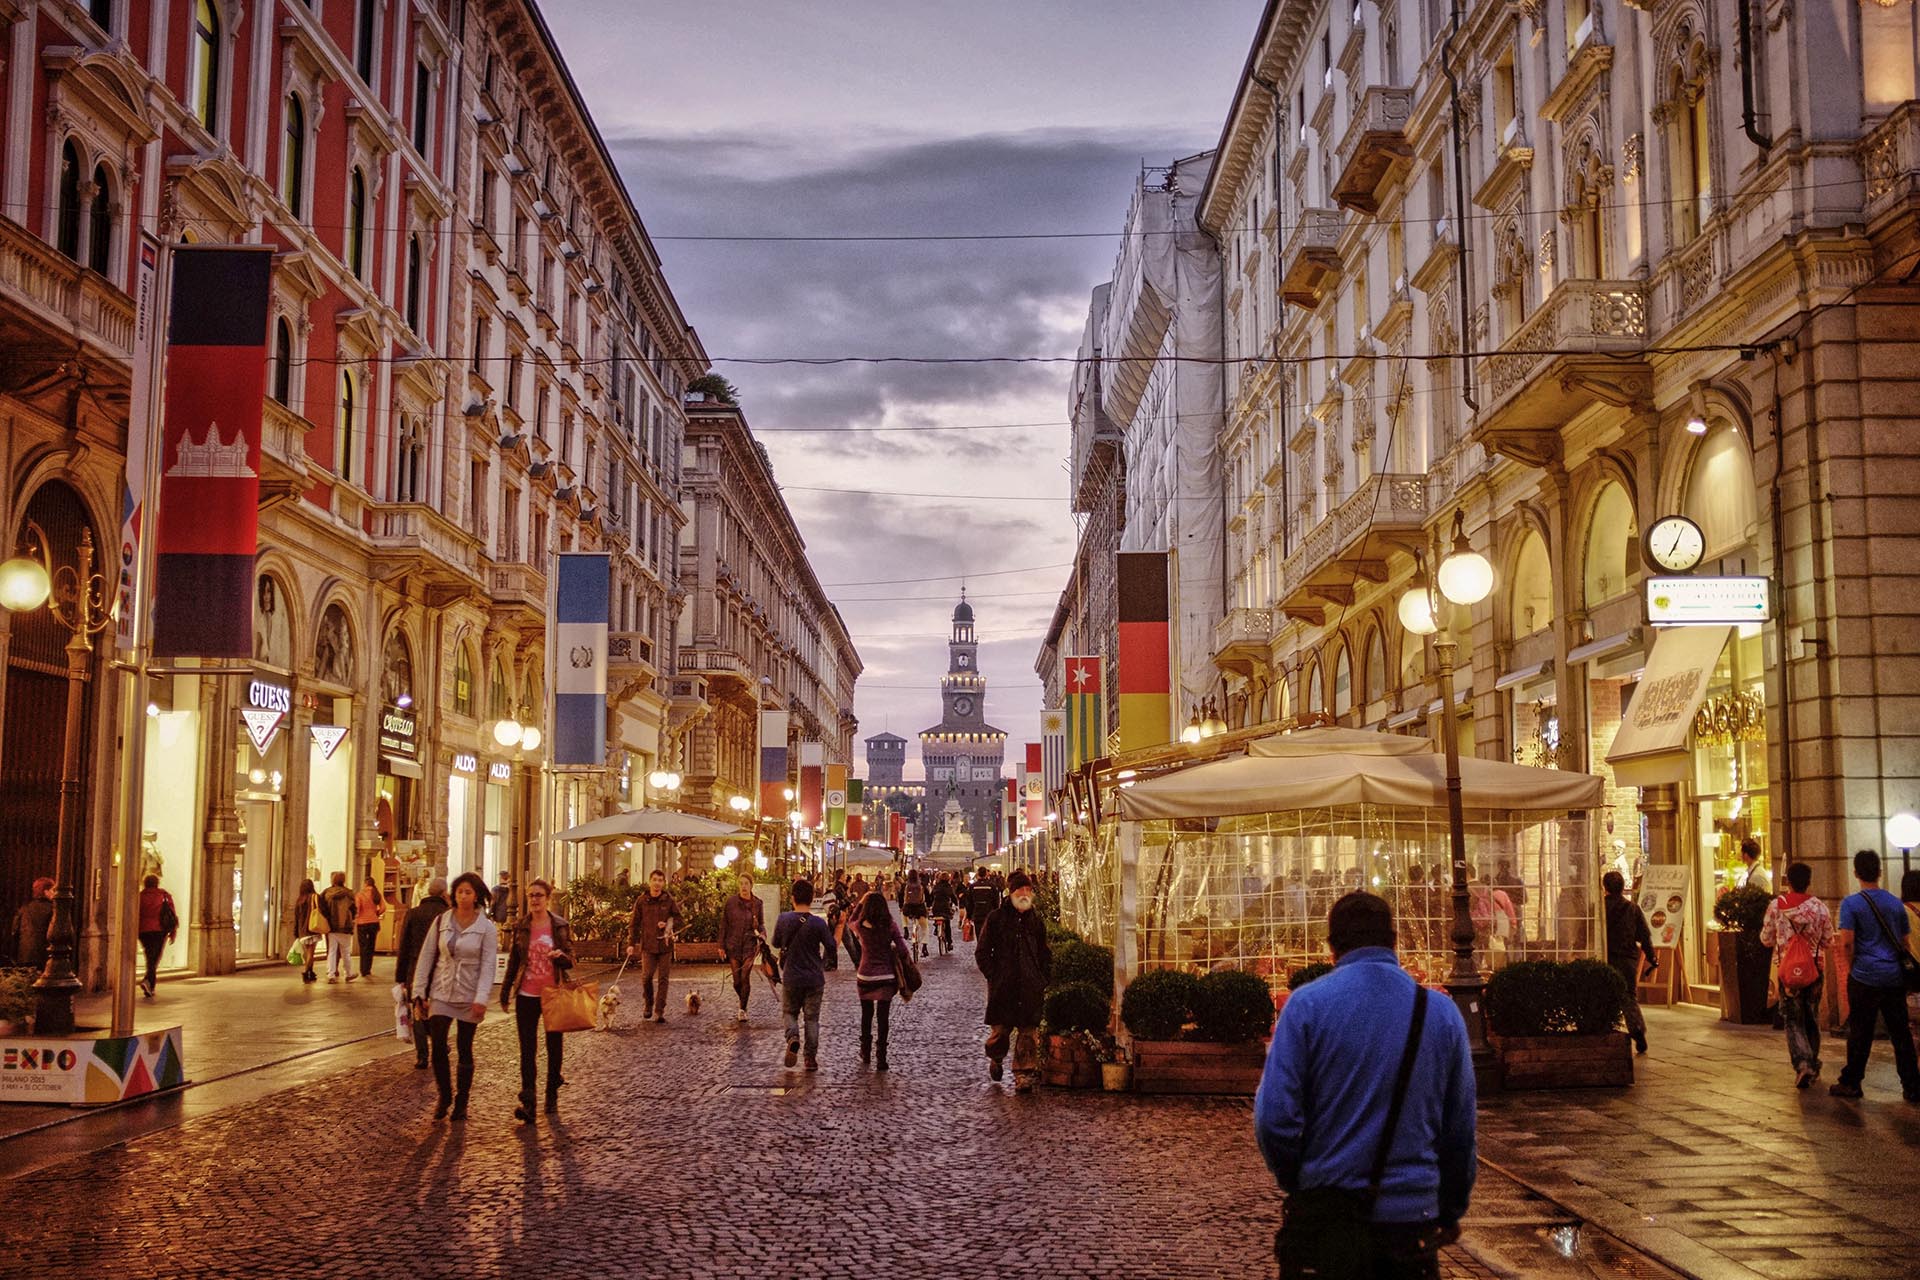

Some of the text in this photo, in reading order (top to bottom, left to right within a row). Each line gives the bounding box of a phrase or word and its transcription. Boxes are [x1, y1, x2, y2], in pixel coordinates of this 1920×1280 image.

[137, 272, 148, 342] cambogia
[117, 541, 133, 637] EXPO
[249, 681, 290, 713] GUESS
[247, 712, 276, 721] GUESS
[315, 729, 341, 737] GUESS
[454, 755, 476, 773] ALDO
[491, 763, 510, 780] ALDO
[3, 1048, 77, 1071] EXPO
